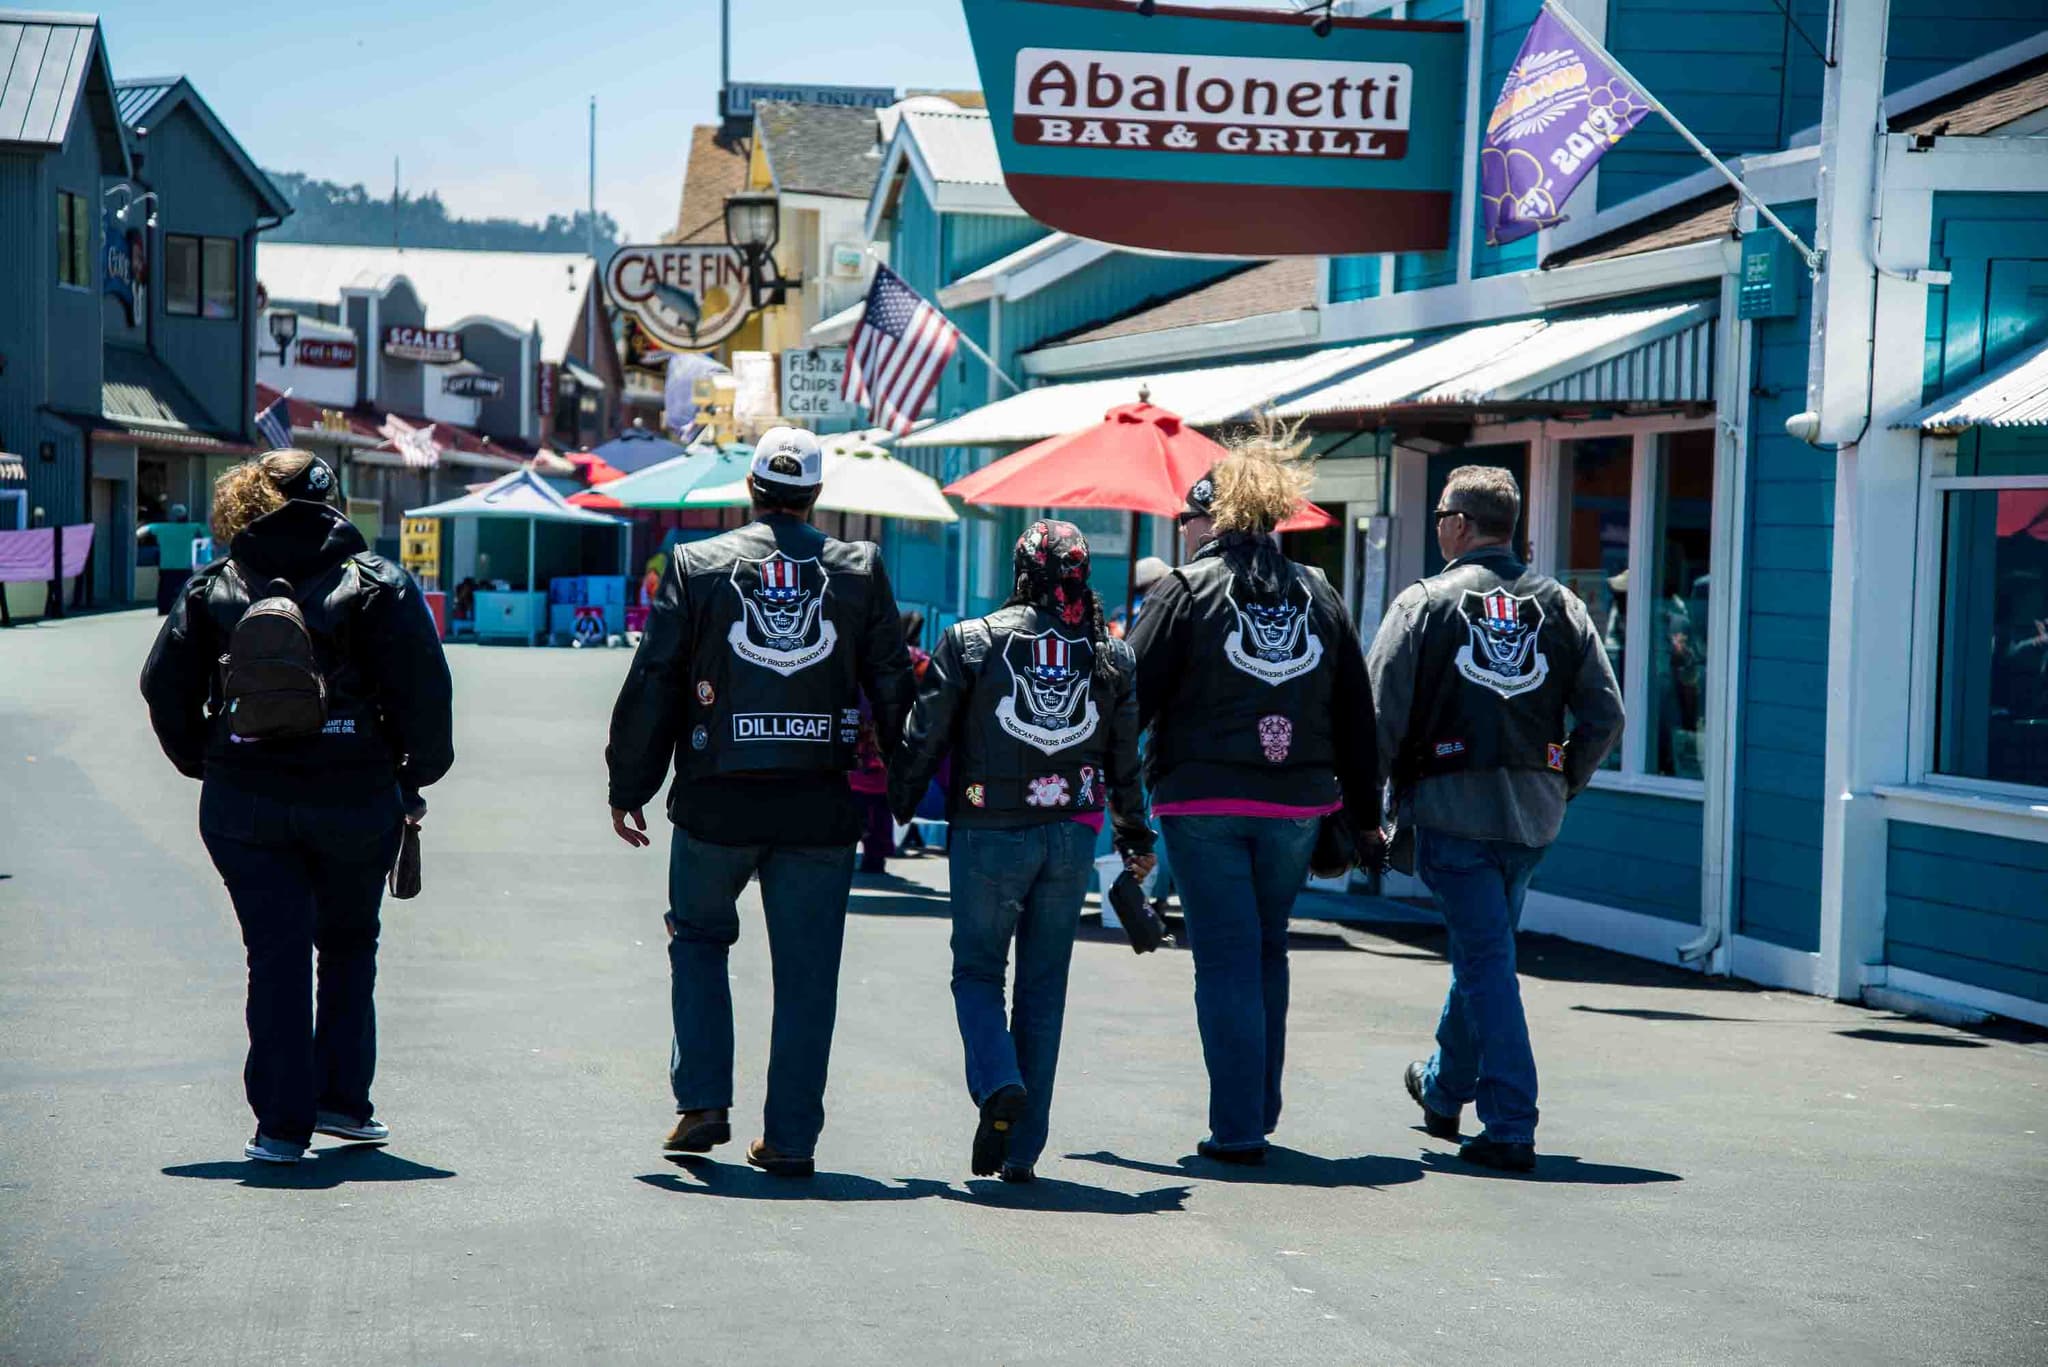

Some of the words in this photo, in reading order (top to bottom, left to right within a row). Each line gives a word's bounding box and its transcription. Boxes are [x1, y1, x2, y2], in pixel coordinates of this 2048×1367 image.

[1027, 60, 1400, 121] Abalonetti
[1037, 118, 1151, 146] BAR
[1163, 124, 1198, 149] &
[1215, 126, 1387, 156] GRILL
[1551, 105, 1619, 175] 2017
[615, 253, 692, 303] CAFE
[390, 328, 457, 350] SCALES
[790, 354, 827, 372] Fish
[790, 374, 837, 392] Chips
[789, 394, 829, 411] Cafe
[737, 641, 767, 663] AMERICAN
[767, 659, 796, 667] BIKERS
[796, 638, 829, 665] ASSOCIATION
[738, 718, 828, 736] DILLIGAF
[1005, 716, 1033, 739] AMERICAN
[1033, 735, 1059, 746] BIKERS
[1060, 719, 1093, 744] ASSOCIATION
